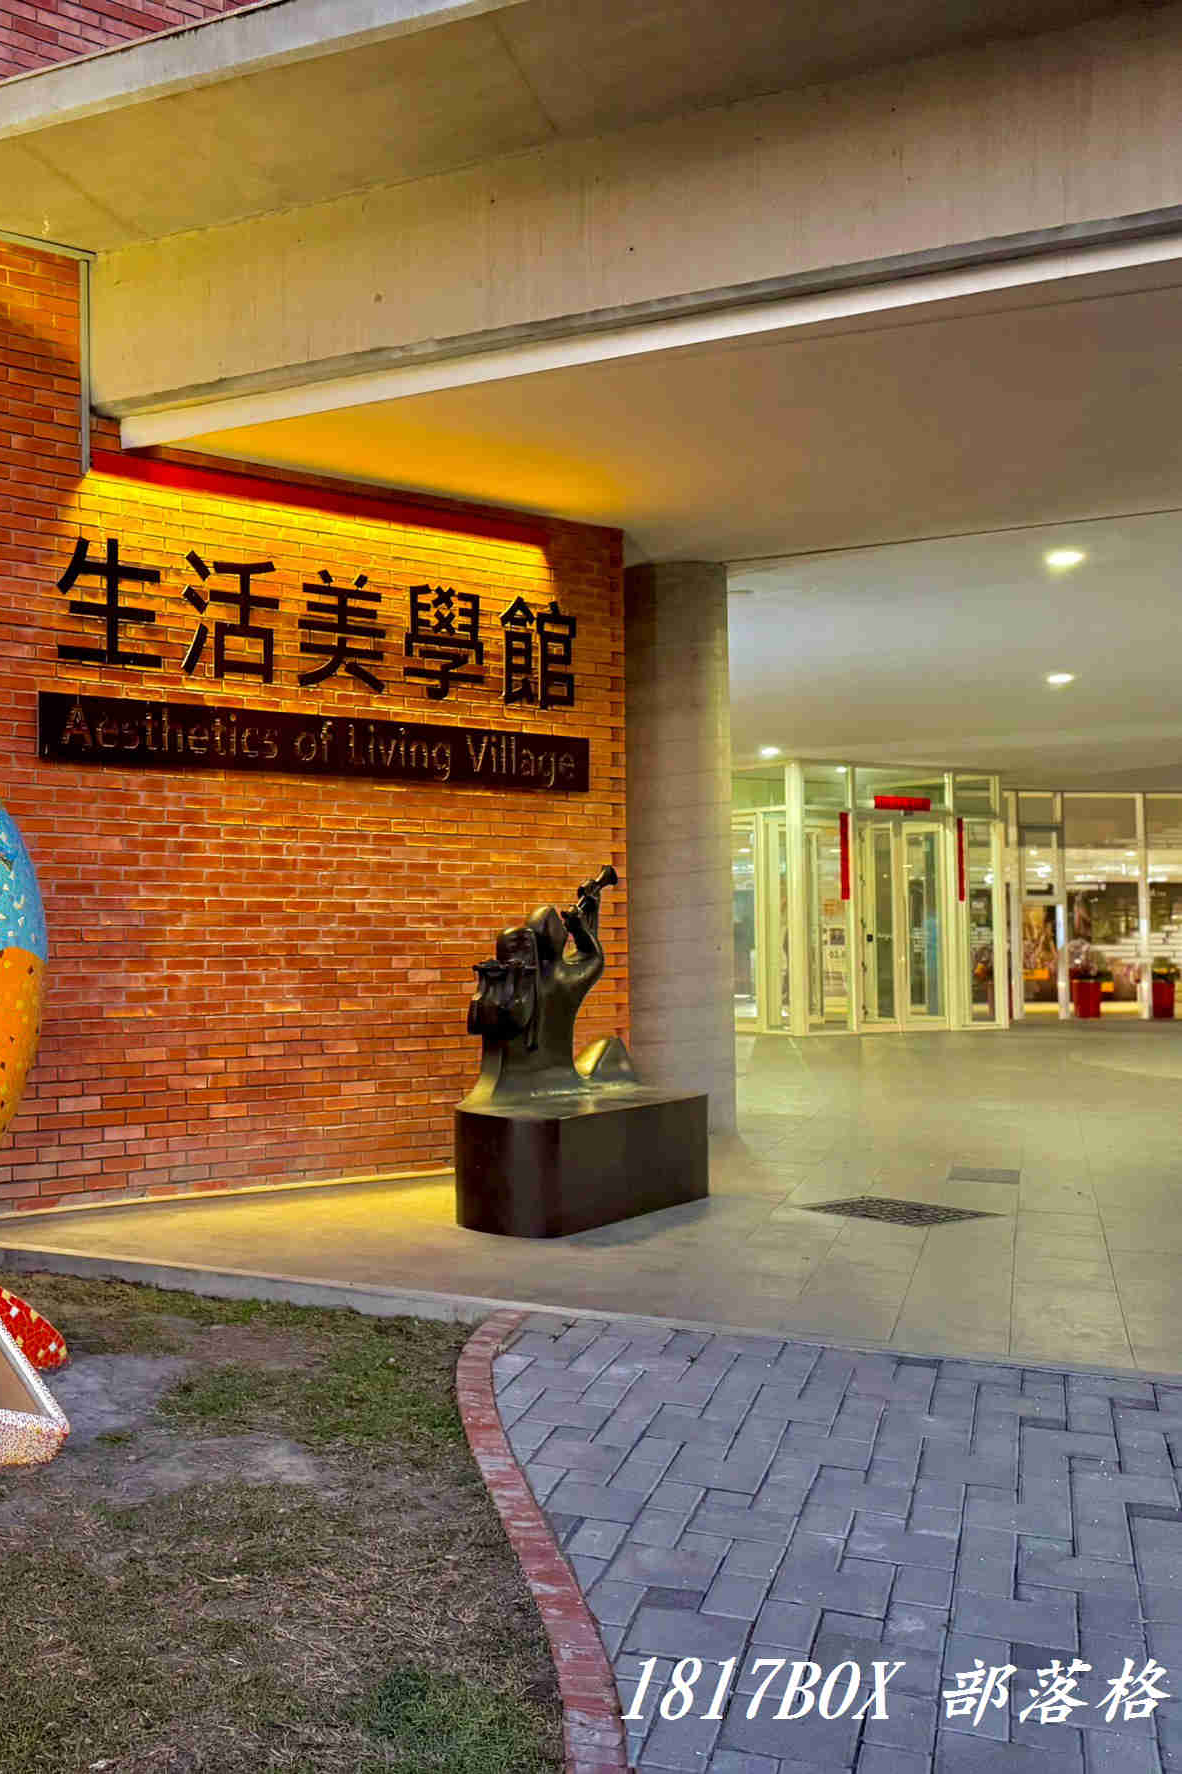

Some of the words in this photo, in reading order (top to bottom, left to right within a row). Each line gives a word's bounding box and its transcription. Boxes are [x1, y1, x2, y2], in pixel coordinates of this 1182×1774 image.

[56, 537, 577, 710] 生活美學館
[61, 702, 279, 761] Aesthetics
[294, 719, 334, 764] of
[348, 722, 452, 782] Living
[466, 734, 577, 788] Village
